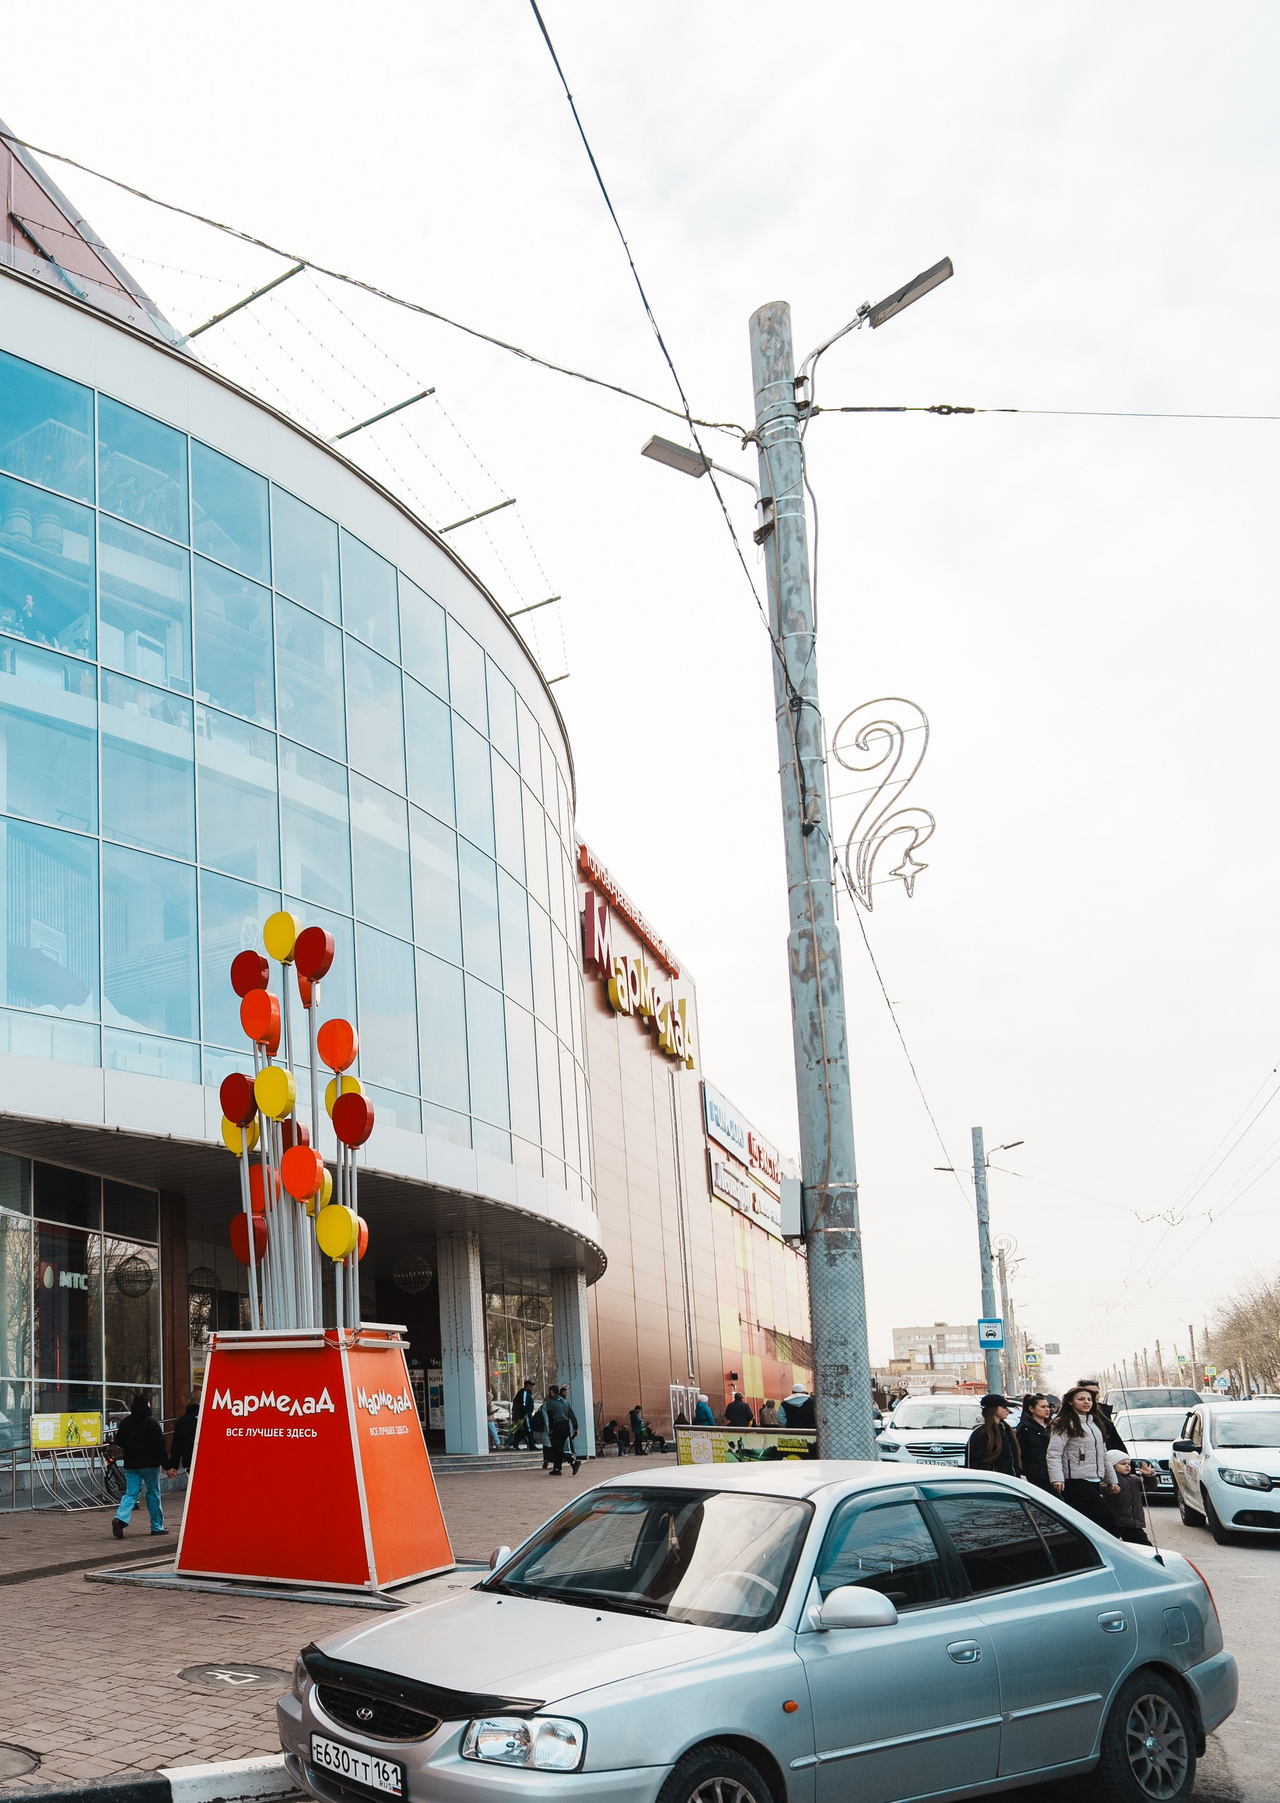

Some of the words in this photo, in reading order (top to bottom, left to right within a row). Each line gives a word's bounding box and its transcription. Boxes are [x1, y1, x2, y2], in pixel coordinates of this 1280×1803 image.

[226, 1428, 243, 1437] ВСЕ
[245, 1428, 284, 1437] ЛУЧШЕЕ
[286, 1428, 318, 1438] ЗДЕСЬ
[370, 1427, 381, 1436] ВСЕ
[381, 1426, 396, 1436] ЛУЧШЕЕ
[396, 1425, 410, 1434] ЗДЕСЬ
[316, 1743, 370, 1781] Е630ТТ
[374, 1761, 400, 1786] 161
[379, 1780, 393, 1791] RUS
